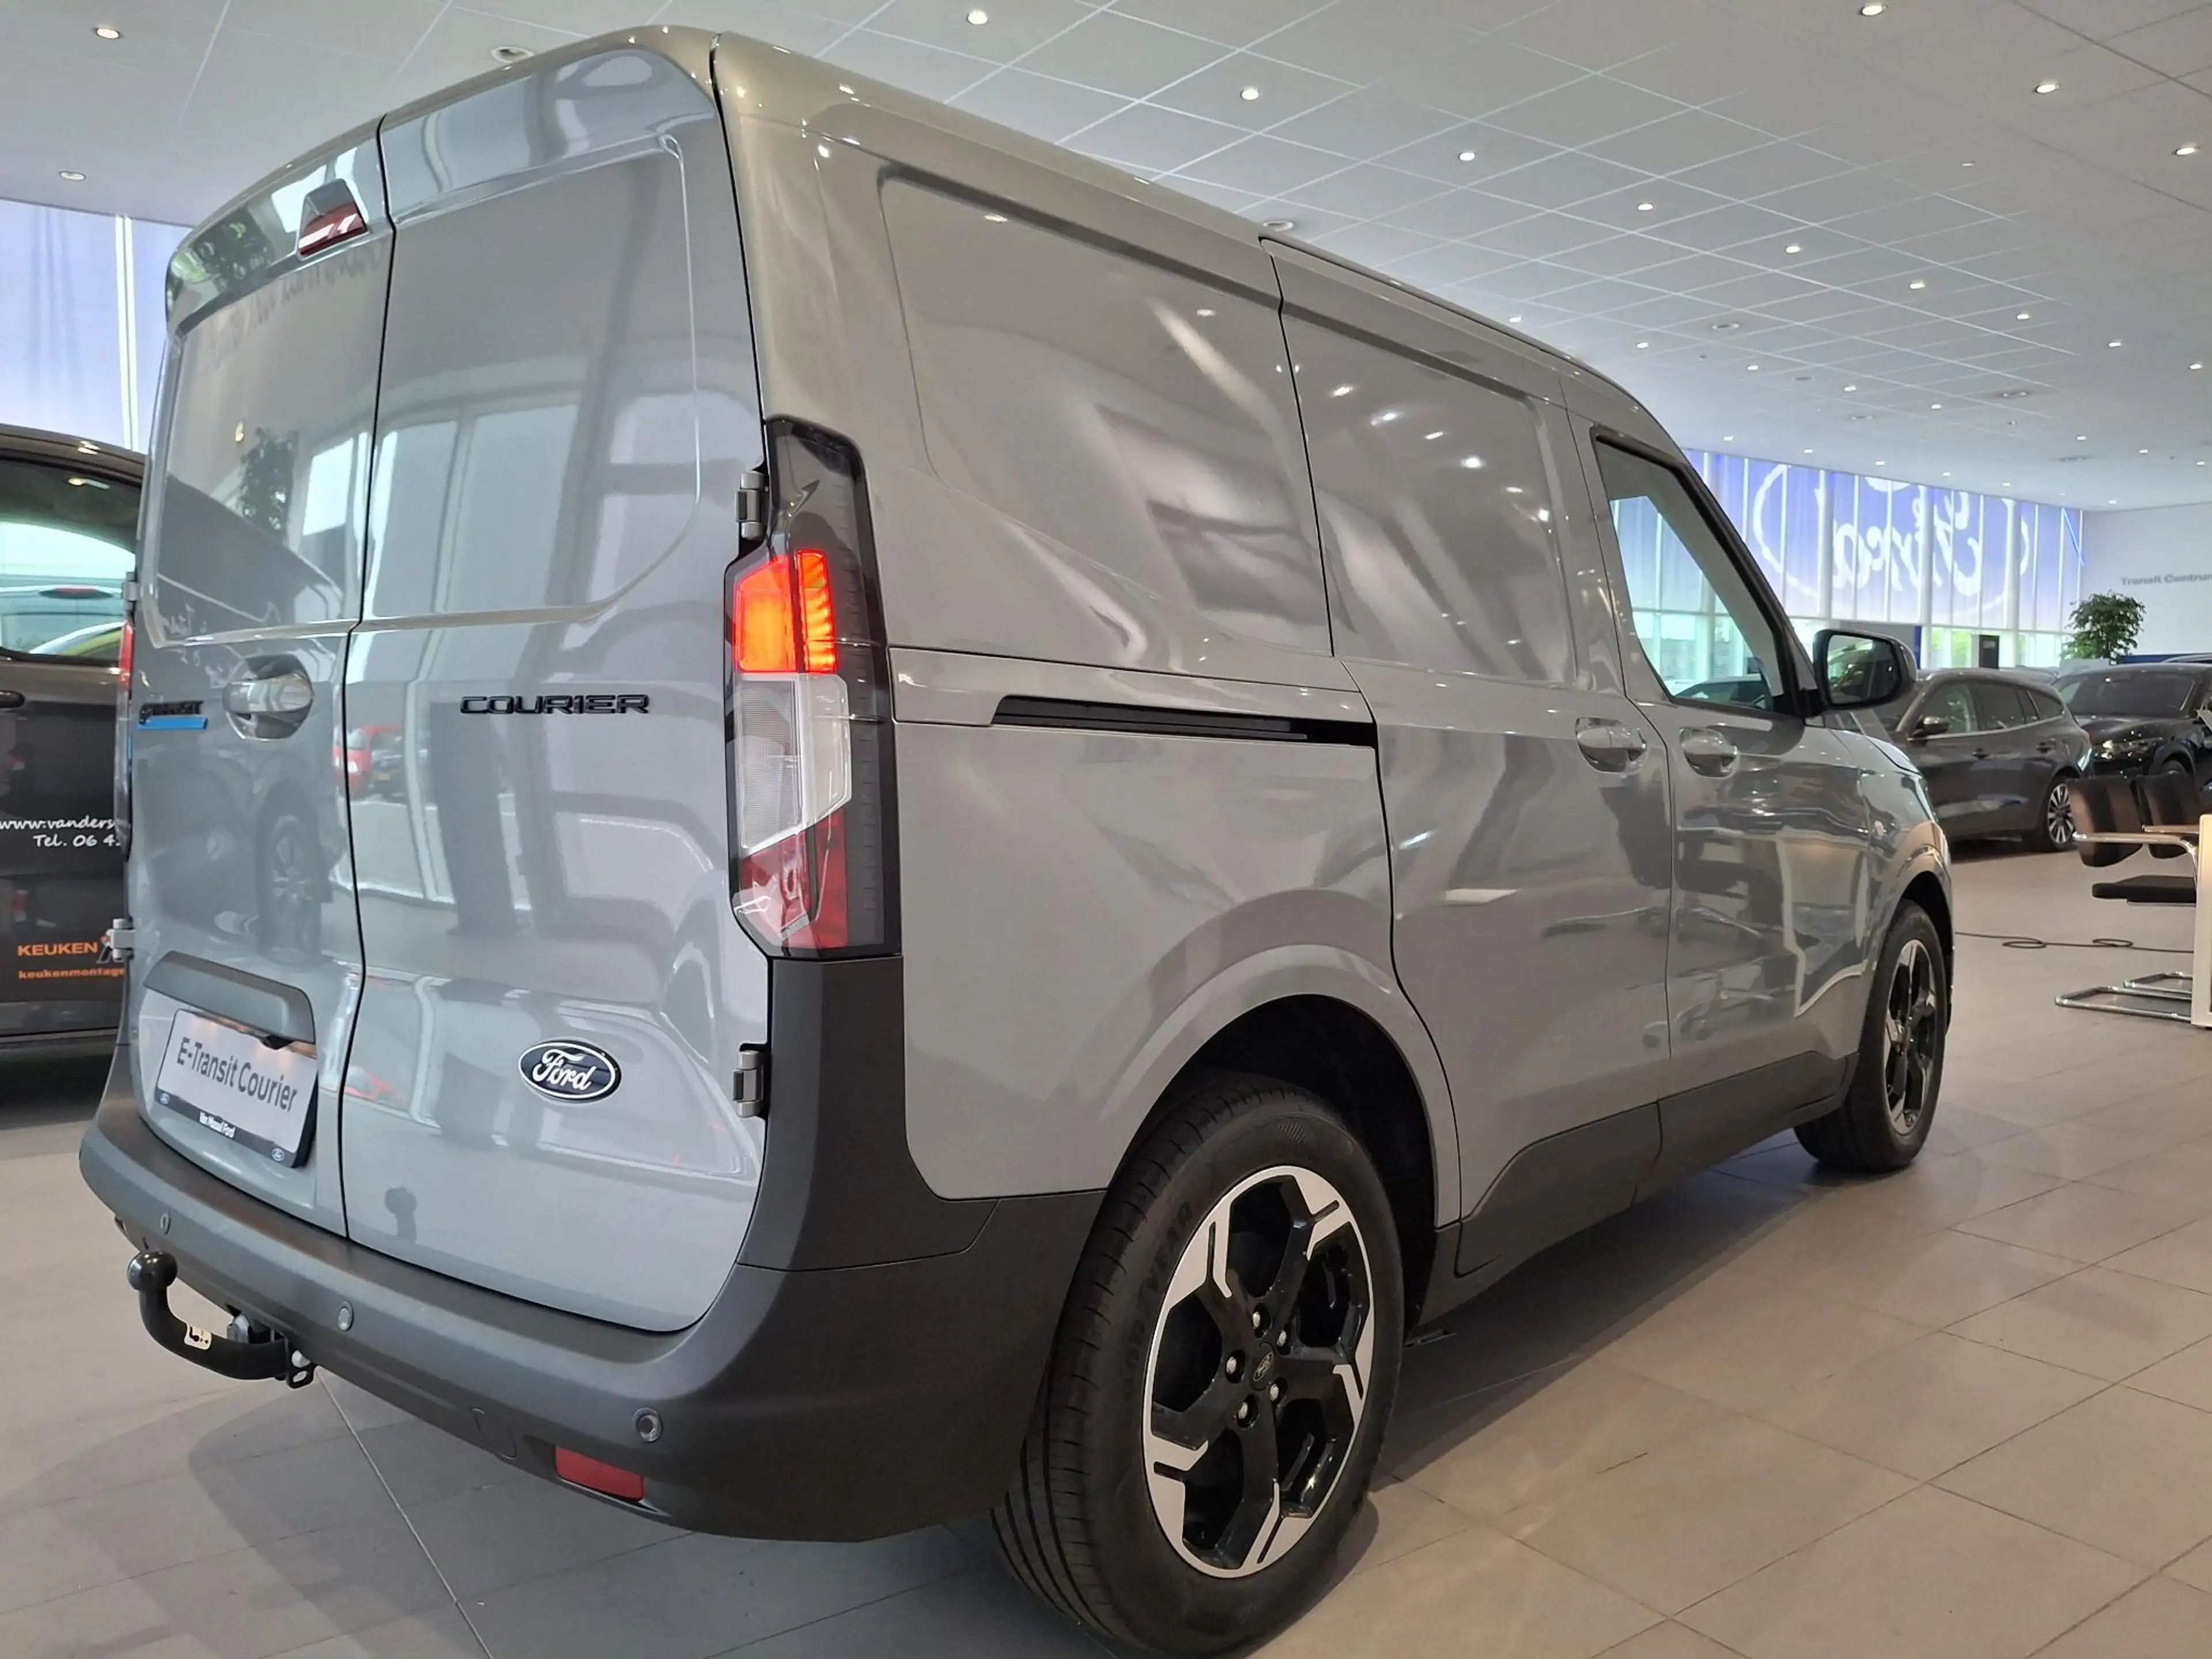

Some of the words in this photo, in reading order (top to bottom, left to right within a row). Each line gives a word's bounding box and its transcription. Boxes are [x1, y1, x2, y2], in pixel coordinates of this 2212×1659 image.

[2122, 575, 2161, 586] Transit
[460, 694, 649, 714] COURIER
[33, 834, 67, 847] Tel.
[73, 834, 97, 847] 06
[17, 941, 99, 957] KEUKEN
[176, 1036, 238, 1088] E-Transit
[237, 1062, 298, 1112] Courier
[532, 1048, 597, 1090] Ford
